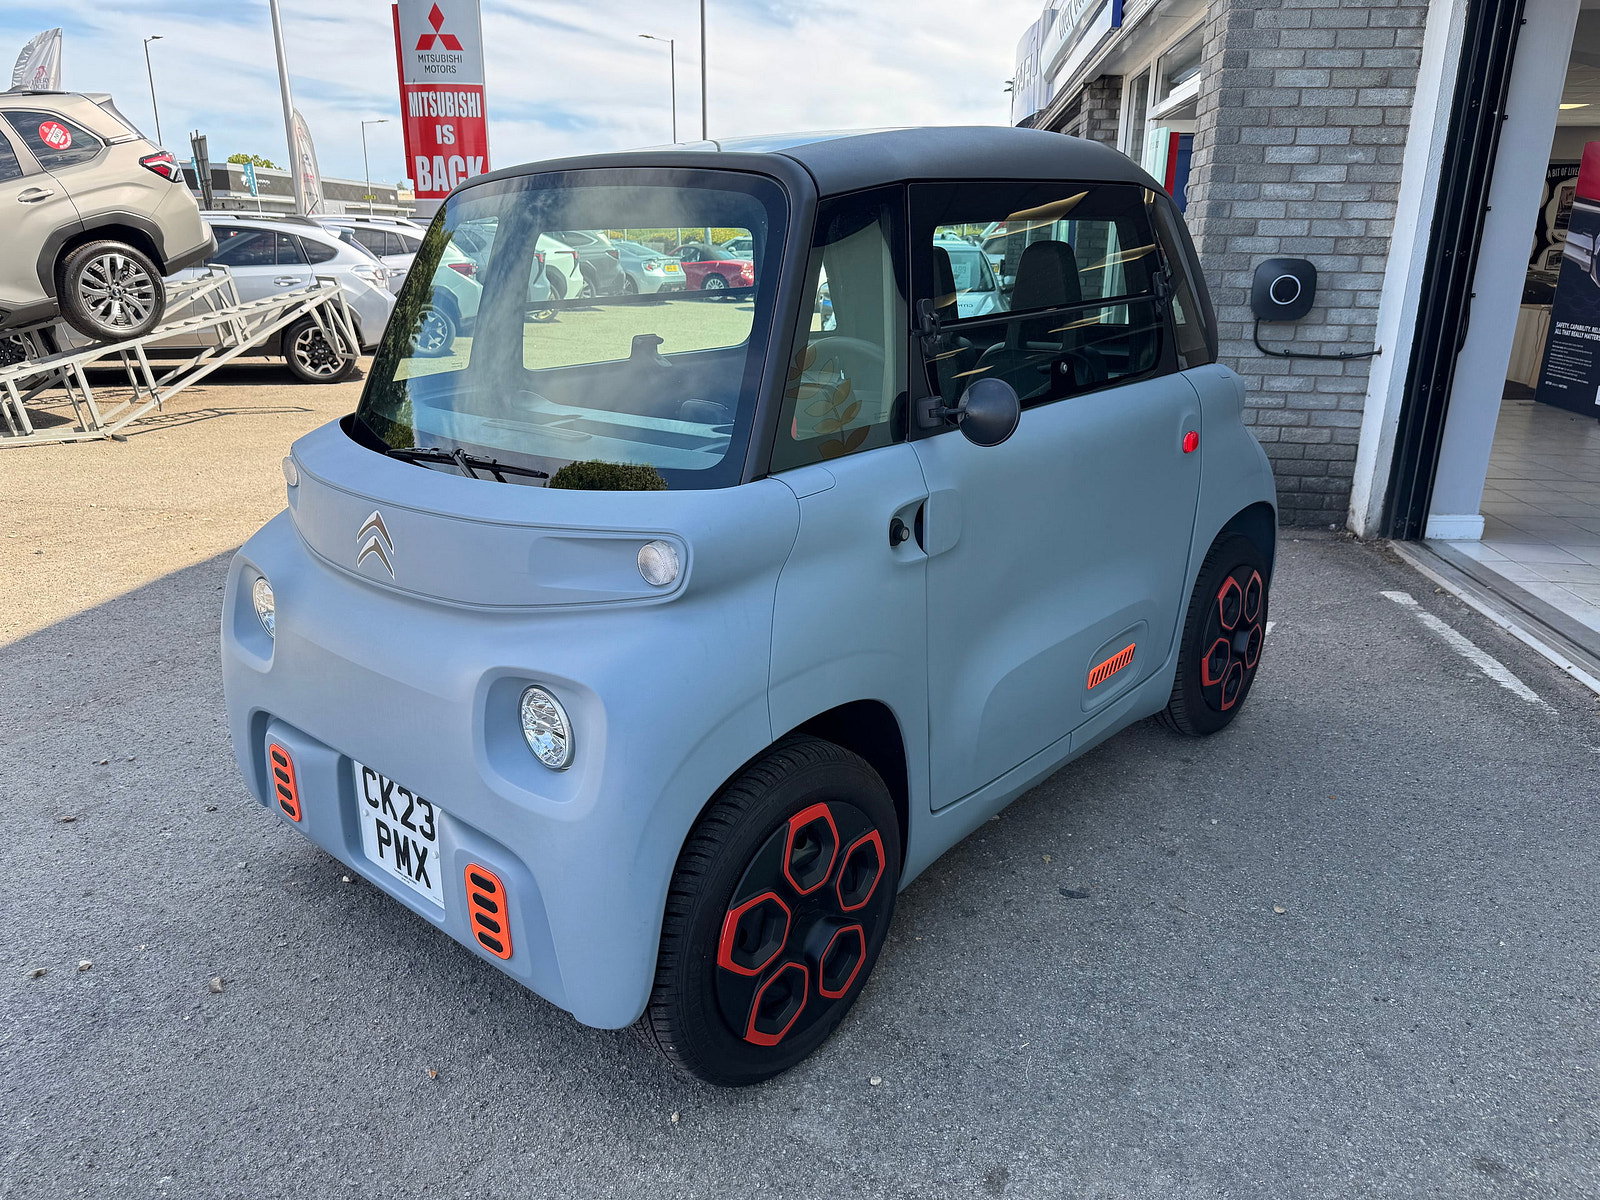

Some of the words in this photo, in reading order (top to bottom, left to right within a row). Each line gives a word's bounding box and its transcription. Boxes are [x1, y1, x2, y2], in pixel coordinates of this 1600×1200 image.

[417, 54, 463, 63] MITSUBISHI
[424, 65, 457, 74] MOTORS
[408, 91, 482, 118] MITSUBISHI
[435, 124, 455, 145] IS
[415, 155, 484, 192] BACK
[1552, 168, 1560, 178] BIT
[1560, 167, 1568, 177] OF
[1571, 330, 1584, 338] REALLY
[362, 765, 436, 842] CK23
[375, 817, 432, 890] PMX
